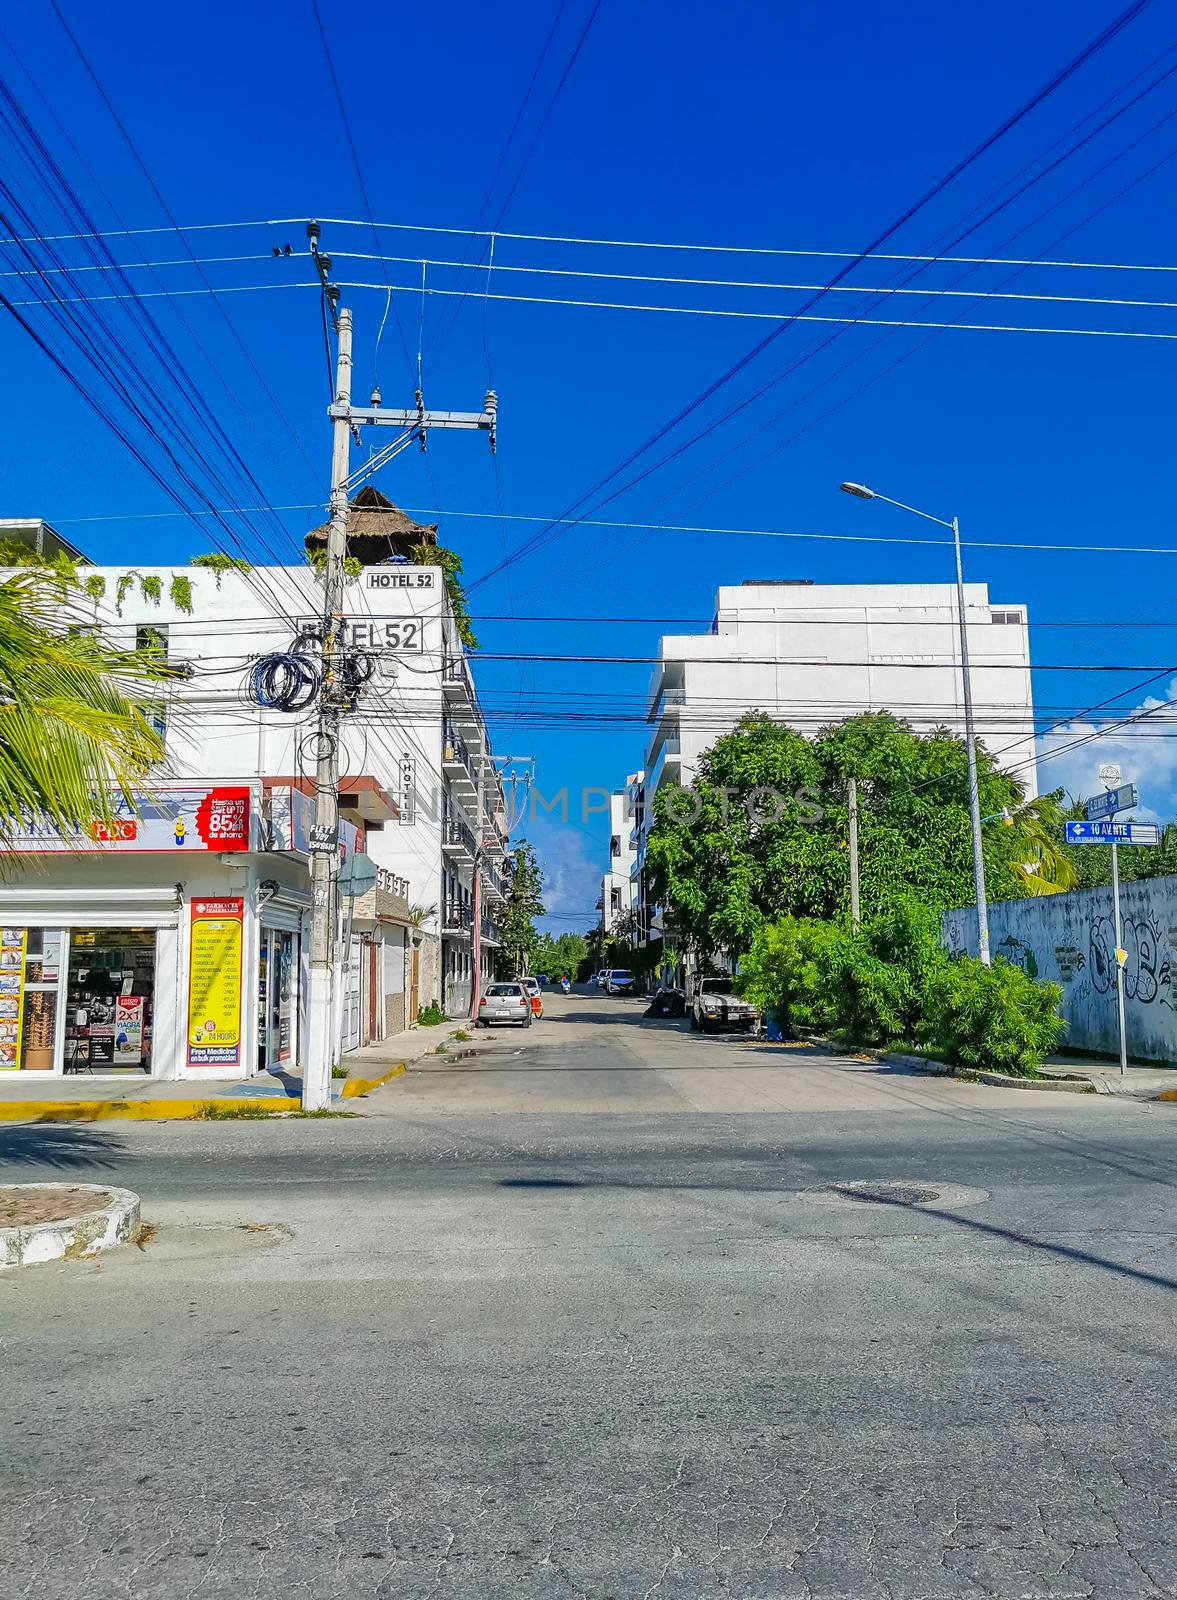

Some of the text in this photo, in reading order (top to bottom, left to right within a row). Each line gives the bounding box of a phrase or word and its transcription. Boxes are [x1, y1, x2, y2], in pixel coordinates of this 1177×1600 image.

[370, 574, 432, 588] HOTEL 52
[403, 764, 412, 810] HOTEL
[211, 805, 245, 814] SAVE UP TO
[310, 824, 336, 834] FLETE
[1091, 823, 1101, 835] 10
[1113, 824, 1129, 836] NTE
[219, 831, 244, 839] ahorro
[118, 1010, 139, 1020] 2x1
[208, 1032, 237, 1041] 24 HOURS
[207, 1047, 237, 1055] Medicine
